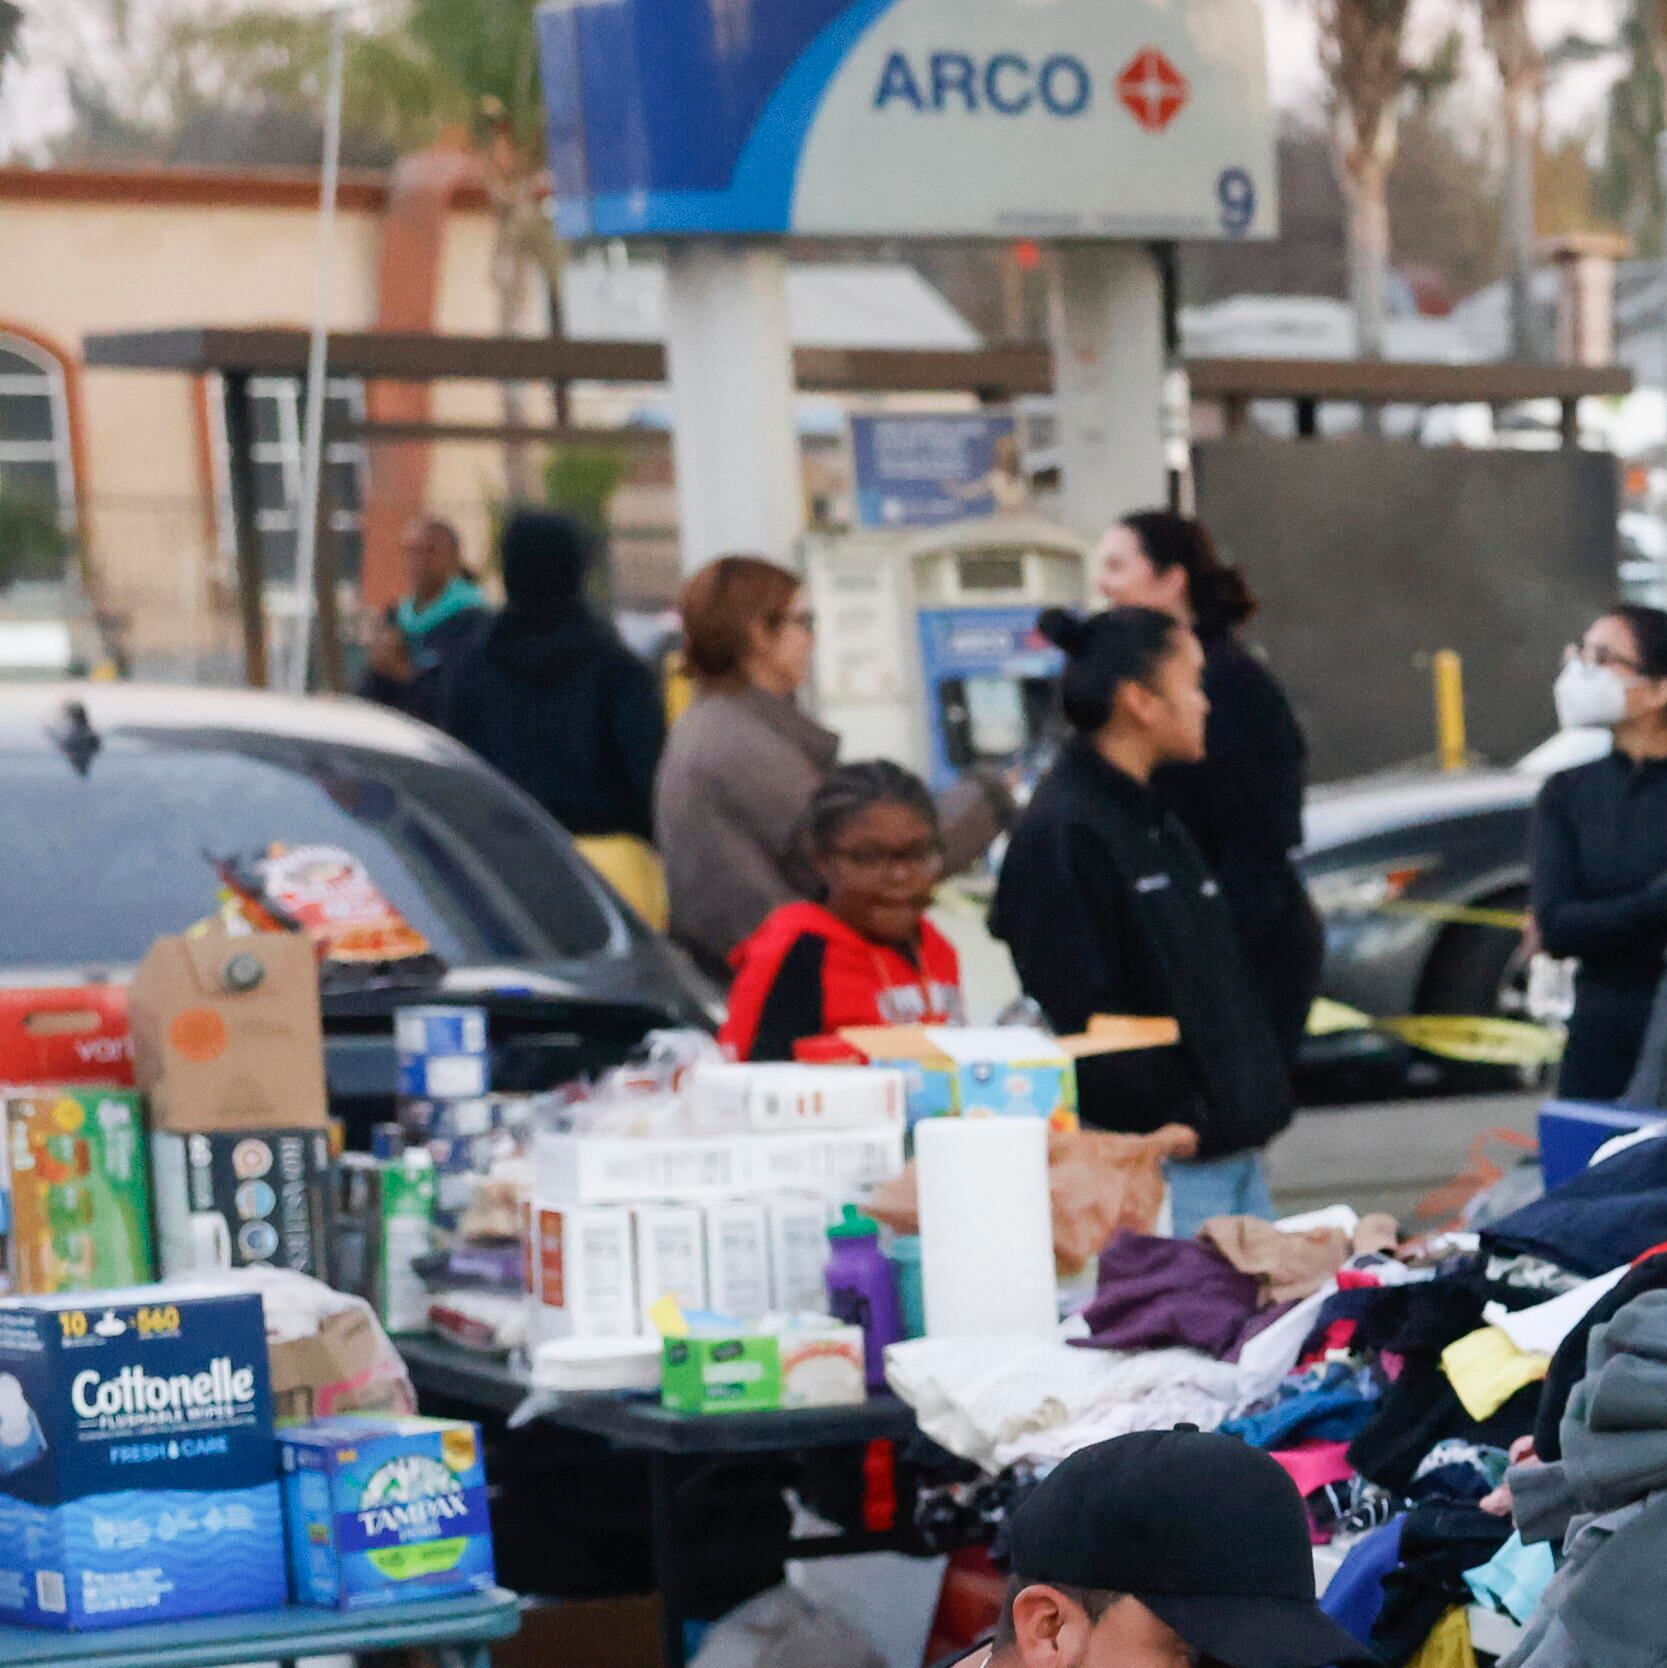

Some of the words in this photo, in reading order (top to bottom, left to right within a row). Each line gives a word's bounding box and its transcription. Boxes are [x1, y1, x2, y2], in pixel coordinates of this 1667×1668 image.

[874, 50, 1091, 116] ARCO
[1218, 167, 1254, 236] 9
[59, 1310, 88, 1338] 10
[71, 1356, 256, 1419] Cottonelle
[358, 1493, 468, 1537] TAMPAX
